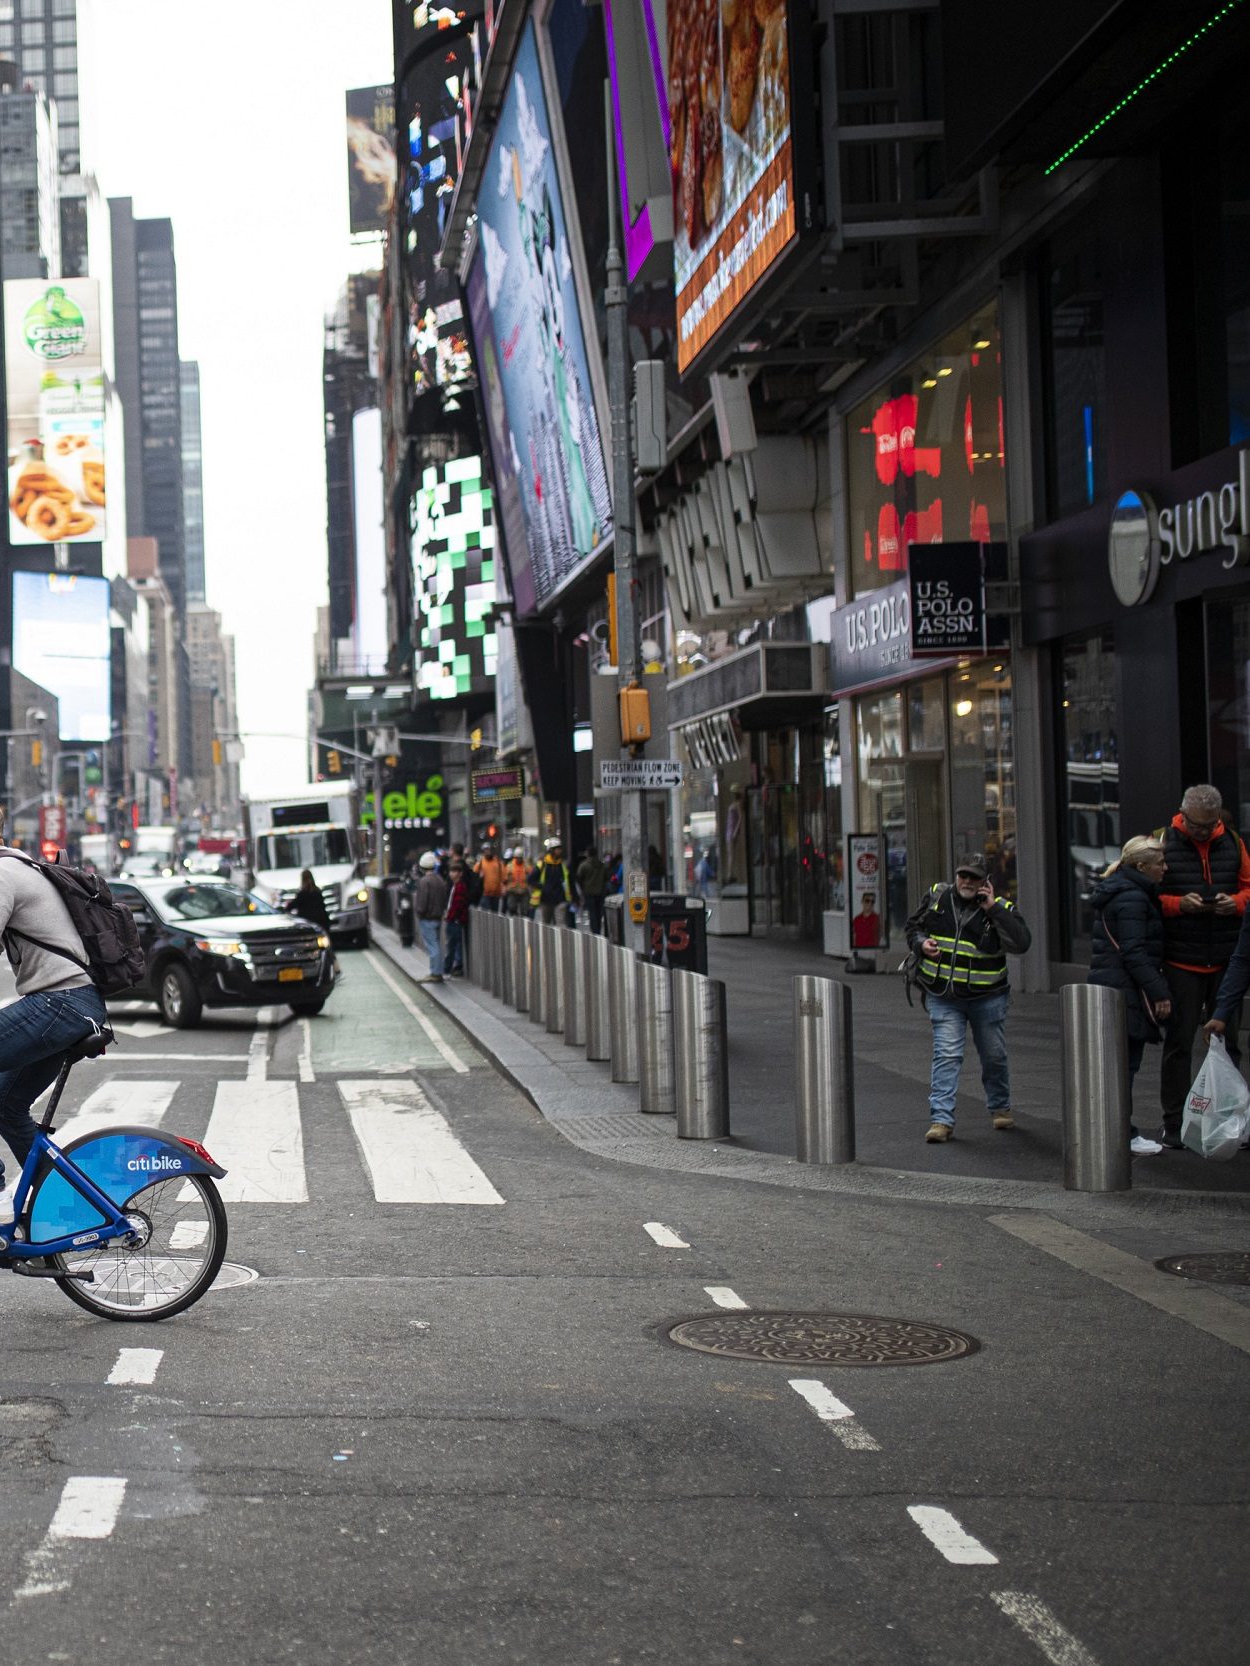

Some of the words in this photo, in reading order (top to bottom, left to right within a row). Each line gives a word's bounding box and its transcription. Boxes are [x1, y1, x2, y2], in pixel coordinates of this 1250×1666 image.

[917, 580, 955, 599] U.S.
[917, 597, 974, 617] POLO
[845, 608, 870, 655] U.S.
[918, 615, 979, 635] ASSN.
[602, 763, 643, 773] PEDESTRIAN
[644, 763, 662, 773] FLOW
[664, 763, 680, 773] ZONE
[603, 776, 619, 787] KEEP
[621, 776, 647, 787] MOVING
[127, 1156, 150, 1171] citi
[151, 1156, 182, 1170] bike
